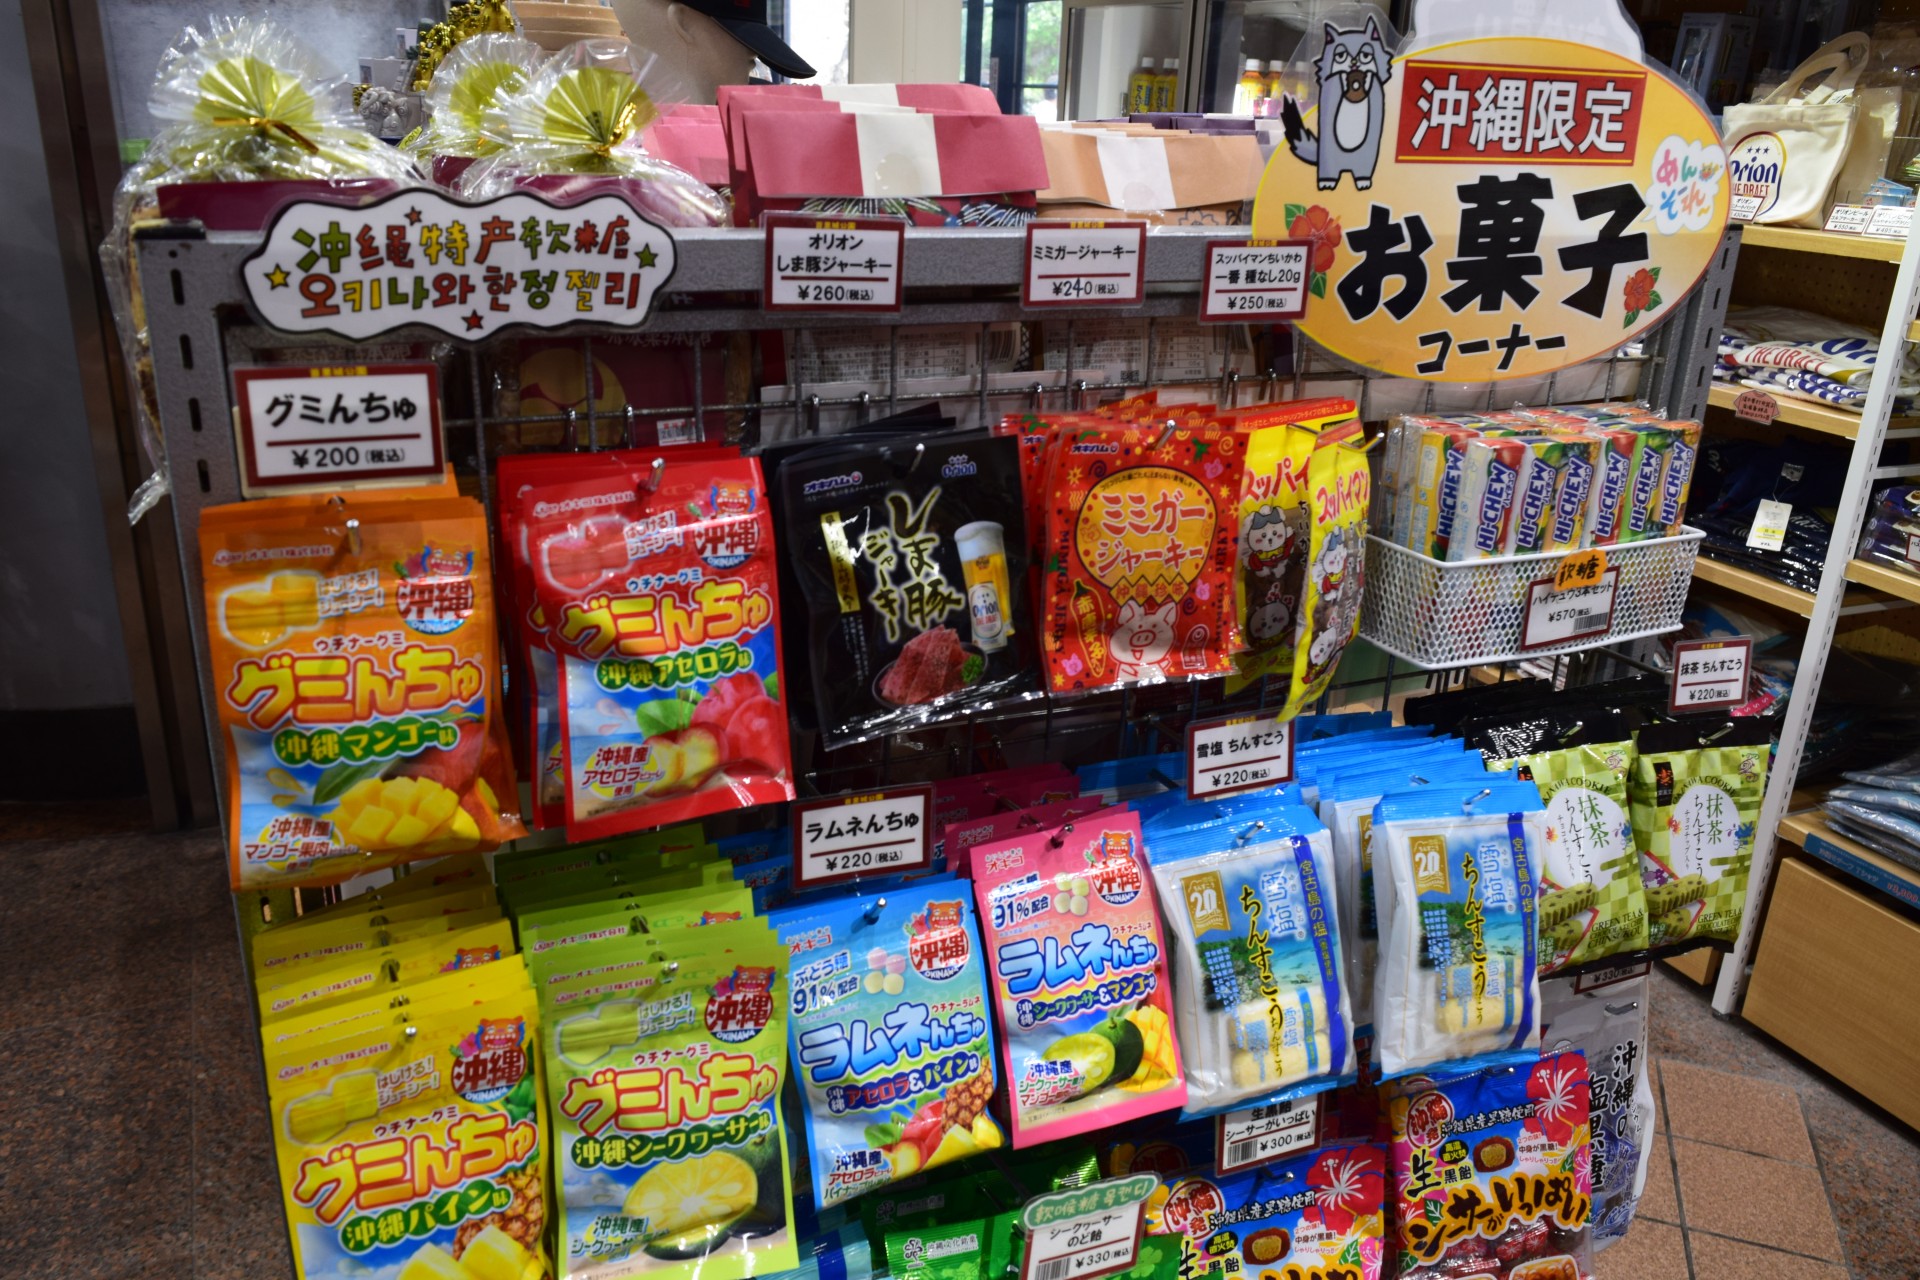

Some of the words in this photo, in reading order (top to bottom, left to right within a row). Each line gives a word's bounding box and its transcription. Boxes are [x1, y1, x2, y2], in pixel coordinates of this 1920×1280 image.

[1411, 74, 1633, 154] 沖縄限定
[1655, 148, 1697, 186] めん
[808, 233, 863, 250] オリオン
[1033, 245, 1137, 261] ミミガージャーキー
[1335, 172, 1650, 321] お菓子
[777, 255, 892, 273] しま豚ジャーキー
[299, 272, 474, 317] 오키나와
[482, 266, 555, 312] 한정
[565, 269, 641, 312] 젤리
[1417, 324, 1566, 375] コーナー
[265, 392, 418, 428] グミんちゅ
[942, 463, 976, 477] Orion
[1629, 446, 1659, 531] HI-CHEW
[1660, 441, 1690, 525] HI-CHEW
[1101, 489, 1206, 536] ミミガー
[1316, 470, 1369, 524] スッパイマン
[1476, 463, 1511, 550] HI-CHEW
[1517, 458, 1552, 547] HI-CHEW
[1553, 455, 1588, 543] HI-CHEW
[1596, 452, 1626, 536] HI-CHEW
[695, 513, 758, 554] 沖縄
[706, 555, 746, 568] OKINAWA
[887, 487, 963, 629] しま豚
[1098, 537, 1205, 575] ジャーキー
[396, 577, 474, 621] 沖縄
[627, 568, 703, 592] ウチナーグミ
[866, 530, 902, 642] ジャーキー
[557, 582, 771, 657] グミんちゅ
[972, 602, 999, 617] Orion
[314, 632, 404, 651] ウチナーグミ
[598, 644, 753, 688] 沖縄アセロラ味
[1680, 661, 1699, 676] 抹茶
[1702, 659, 1743, 673] ちんすこう
[226, 643, 484, 729] グミんちゅ
[275, 720, 458, 763] 沖縄マンゴー味
[595, 745, 649, 766] 沖縄産
[1196, 741, 1224, 759] 雪塩
[1228, 731, 1285, 753] ちんすこう
[269, 817, 331, 839] 沖縄産
[805, 811, 920, 844] ラムネんちゅ
[1578, 794, 1611, 849] 抹茶
[1692, 794, 1706, 879] ちんすこう
[1706, 793, 1724, 845] 抹茶
[1565, 797, 1594, 890] ちんすこう
[987, 855, 1024, 873] オキコ
[1414, 851, 1441, 878] 20
[1104, 892, 1136, 903] OKINAWA
[1190, 889, 1218, 918] 20
[1299, 860, 1329, 938] 宮古島の塩
[1462, 852, 1488, 995] ちんすこう
[1591, 914, 1621, 933] GREEN
[1622, 909, 1638, 922] TEA
[1697, 911, 1723, 924] GREEN
[790, 934, 832, 956] オキコ
[910, 935, 969, 973] 沖縄
[998, 923, 1158, 994] ラムネんちゅ
[1239, 885, 1284, 1030] ちんすこう
[794, 951, 849, 988] ぶどう糖
[924, 966, 959, 980] OKINAWA
[704, 992, 773, 1031] 沖縄
[633, 1043, 711, 1067] ウチナーグミ
[715, 1029, 756, 1043] OKINAWA
[799, 1001, 986, 1083] ラムネんちゅ
[452, 1050, 525, 1092] 沖縄
[1030, 1059, 1073, 1078] 沖縄産
[464, 1086, 509, 1101] OKINAWA
[561, 1051, 778, 1137] グミんちゅ
[1611, 1040, 1638, 1138] 沖縄の
[374, 1106, 459, 1137] ウチナーグミ
[1226, 1109, 1316, 1142] シーサーがいっぱい
[1440, 1102, 1536, 1139] 沖縄県産黒糖使用
[293, 1111, 538, 1223] グミんちゅ
[836, 1150, 882, 1171] 沖縄産
[1406, 1148, 1442, 1198] 生
[1443, 1166, 1472, 1184] 黒飴
[344, 1182, 510, 1249] 沖縄パイン味
[593, 1215, 646, 1235] 沖縄産
[1209, 1190, 1317, 1231] 沖縄県産黒糖使用
[1407, 1174, 1589, 1258] シーサーがいっぱい
[1067, 1229, 1103, 1248] のど飴
[1207, 1256, 1240, 1273] 黒飴
